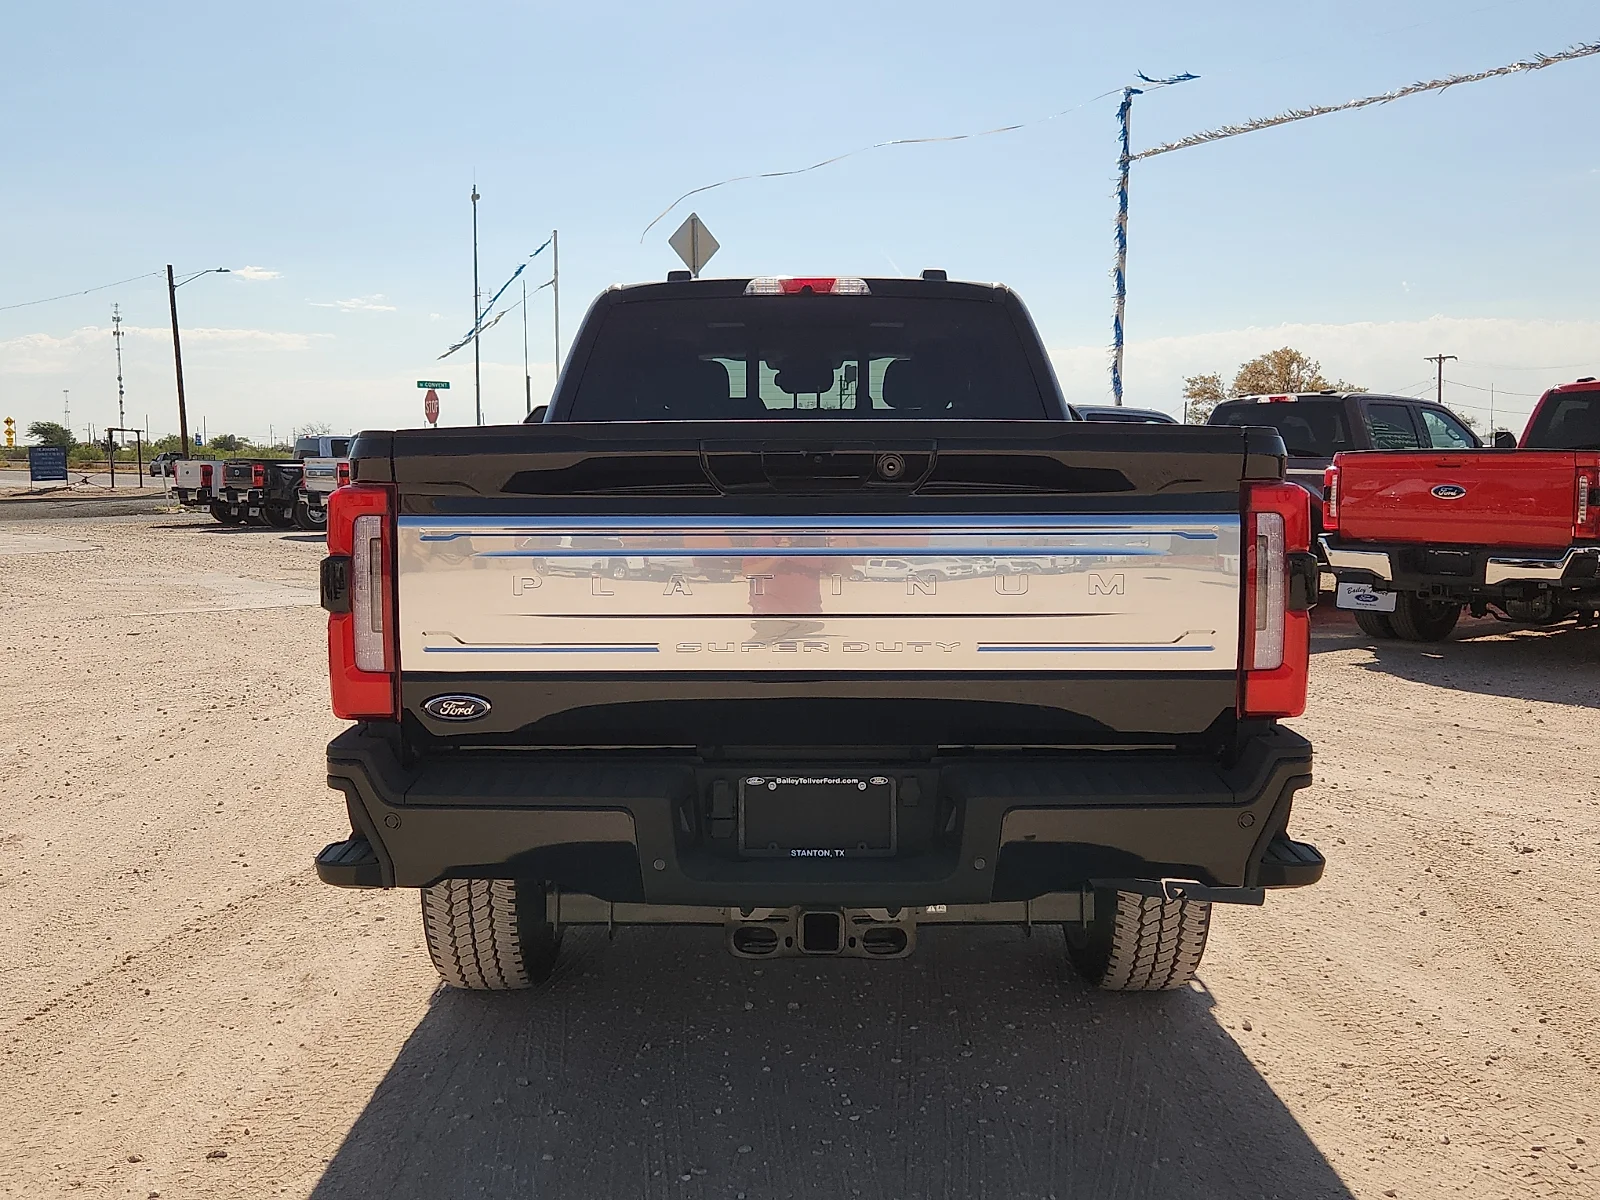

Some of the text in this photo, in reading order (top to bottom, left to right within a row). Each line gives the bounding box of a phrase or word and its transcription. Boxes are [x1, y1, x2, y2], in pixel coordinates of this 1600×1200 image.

[425, 400, 438, 414] STOP
[1438, 487, 1458, 496] Ford
[513, 573, 1126, 597] PLATINUM
[675, 641, 960, 653] SUPER DUTY
[440, 700, 475, 715] Ford
[776, 777, 859, 785] BaileyToliverFord.com
[790, 849, 845, 858] STANTON, TX
